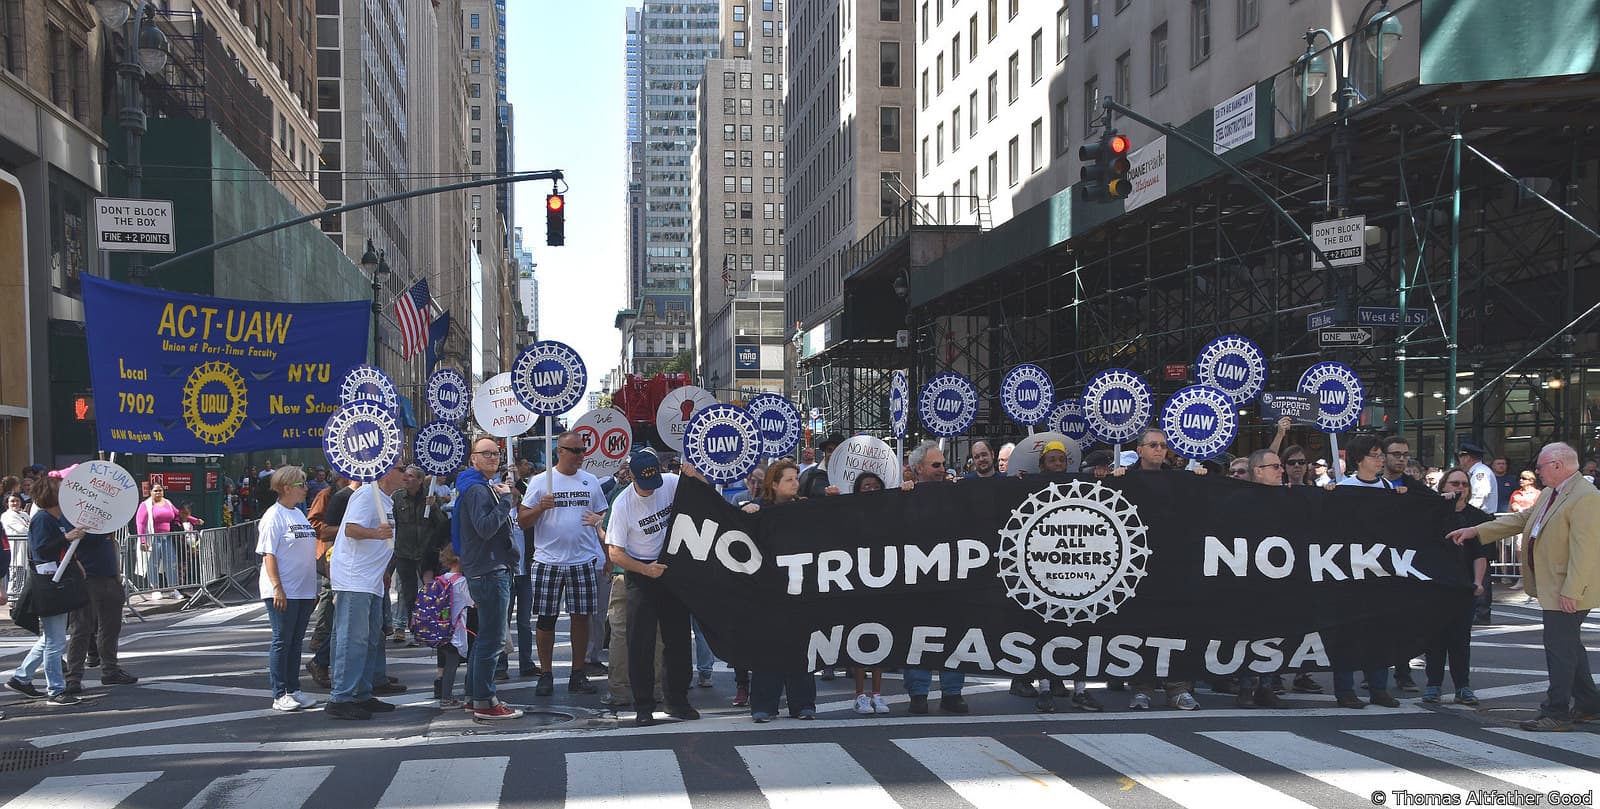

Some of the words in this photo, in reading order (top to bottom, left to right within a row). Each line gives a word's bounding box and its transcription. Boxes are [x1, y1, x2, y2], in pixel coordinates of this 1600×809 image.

[101, 206, 130, 215] DON'T
[134, 207, 167, 217] BLOCK
[114, 217, 133, 226] THE
[137, 218, 156, 227] BOX
[104, 232, 122, 241] FINE
[125, 233, 138, 242] +2
[140, 234, 168, 243] POINTS
[1316, 227, 1335, 237] DON'T
[1337, 223, 1361, 233] BLOCK
[1324, 236, 1337, 245] THE
[1339, 235, 1353, 244] BOX
[1340, 249, 1361, 258] POINTS
[157, 303, 293, 345] ACT-UAW
[1361, 311, 1386, 322] West
[1389, 312, 1411, 323] 45h
[1414, 313, 1425, 323] St
[1323, 333, 1341, 341] ONE
[1350, 333, 1367, 341] WAY
[162, 340, 188, 353] Union
[190, 342, 198, 353] of
[201, 342, 245, 357] Part-Time
[248, 346, 278, 361] Faculty
[119, 358, 148, 381] Local
[288, 363, 331, 383] NYU
[1217, 361, 1247, 382] UAW
[534, 370, 563, 387] UAW
[439, 389, 459, 404] UAW
[492, 397, 519, 409] TRUM
[1018, 389, 1039, 402] UAW
[1320, 390, 1346, 405] UAW
[118, 392, 155, 415] 7902
[201, 395, 228, 414] UAW
[269, 394, 301, 416] New
[305, 394, 339, 415] Schoo
[937, 398, 962, 415] UAW
[1103, 398, 1132, 415] UAW
[1271, 401, 1311, 411] SUPPORTS
[1281, 408, 1300, 417] DACA
[760, 418, 785, 433] UAW
[1062, 421, 1085, 433] UAW
[1183, 413, 1215, 432] UAW
[111, 428, 126, 441] UAW
[128, 429, 151, 443] Region
[154, 430, 164, 442] 9A
[347, 429, 380, 453] UAW
[430, 441, 452, 455] UAW
[707, 436, 739, 453] UAW
[847, 442, 861, 454] NO
[845, 456, 859, 468] NO
[90, 463, 135, 489] ACT-UAW
[843, 470, 856, 481] NO
[90, 477, 122, 498] AGAINST
[1039, 524, 1107, 537] UNITING
[1055, 538, 1086, 549] ALL
[667, 513, 763, 575] NO
[775, 539, 990, 595] TRUMP
[1031, 551, 1112, 566] WORKERS
[1203, 536, 1296, 579] NO
[1308, 543, 1433, 582] KKK
[807, 622, 893, 672] NO
[905, 626, 1187, 678] FASCIST
[1205, 631, 1331, 675] USA
